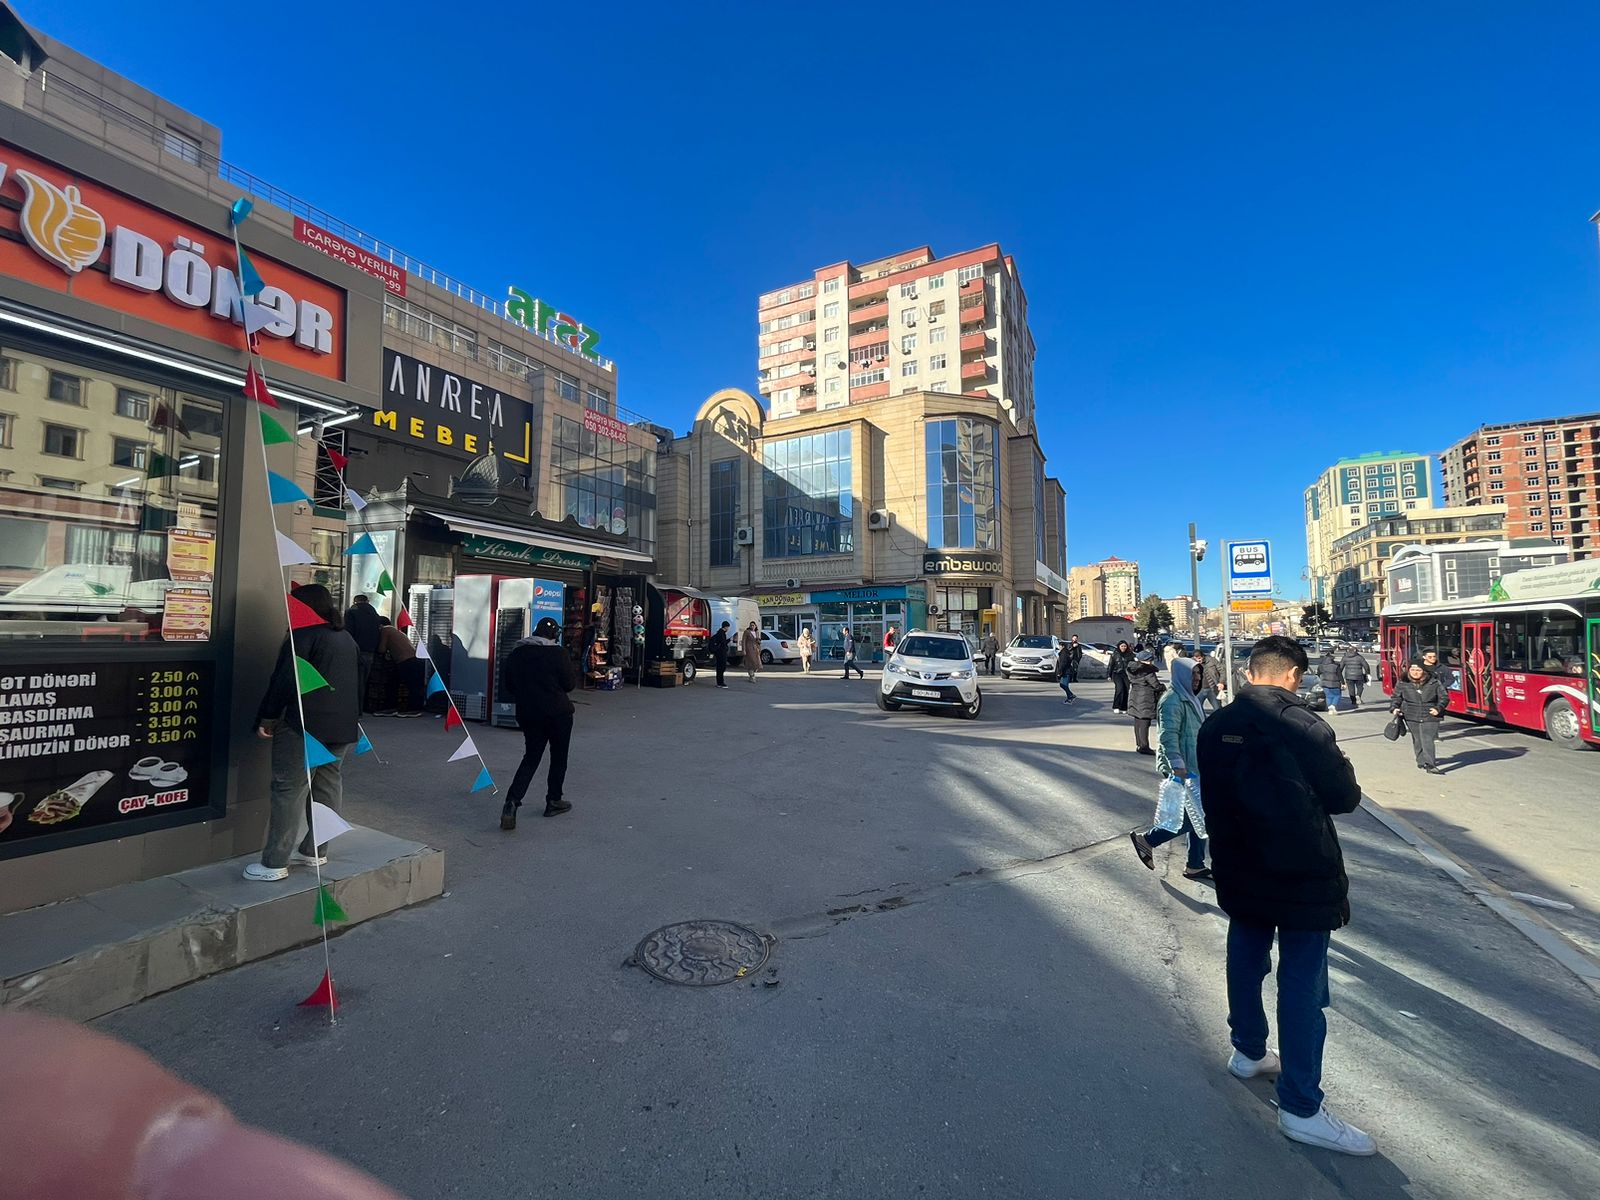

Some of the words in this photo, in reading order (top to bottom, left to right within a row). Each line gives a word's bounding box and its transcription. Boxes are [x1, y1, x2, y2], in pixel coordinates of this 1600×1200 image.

[303, 223, 357, 259] İCARƏYƏ
[359, 253, 400, 280] VERİLİR
[110, 226, 333, 355] DÖNƏR
[505, 285, 600, 361] araz
[585, 420, 597, 431] 050
[475, 540, 532, 560] Kiosk
[542, 550, 582, 567] Press
[1239, 546, 1259, 554] BUS
[925, 556, 1003, 573] embawood
[844, 590, 878, 599] MELIOR
[1, 676, 26, 690] ƏT
[29, 671, 97, 689] DÖNƏRİ
[150, 671, 183, 683] 2.50
[0, 692, 57, 708] LAVAŞ
[150, 686, 183, 698] 3.00
[0, 706, 94, 724] BASDIRMA
[149, 700, 182, 713] 3.00
[0, 723, 75, 744] ŞAURMA
[148, 716, 181, 728] 3.50
[0, 739, 69, 760] LİMUZİN
[74, 734, 130, 752] DÖNƏR
[147, 730, 180, 744] 3.50
